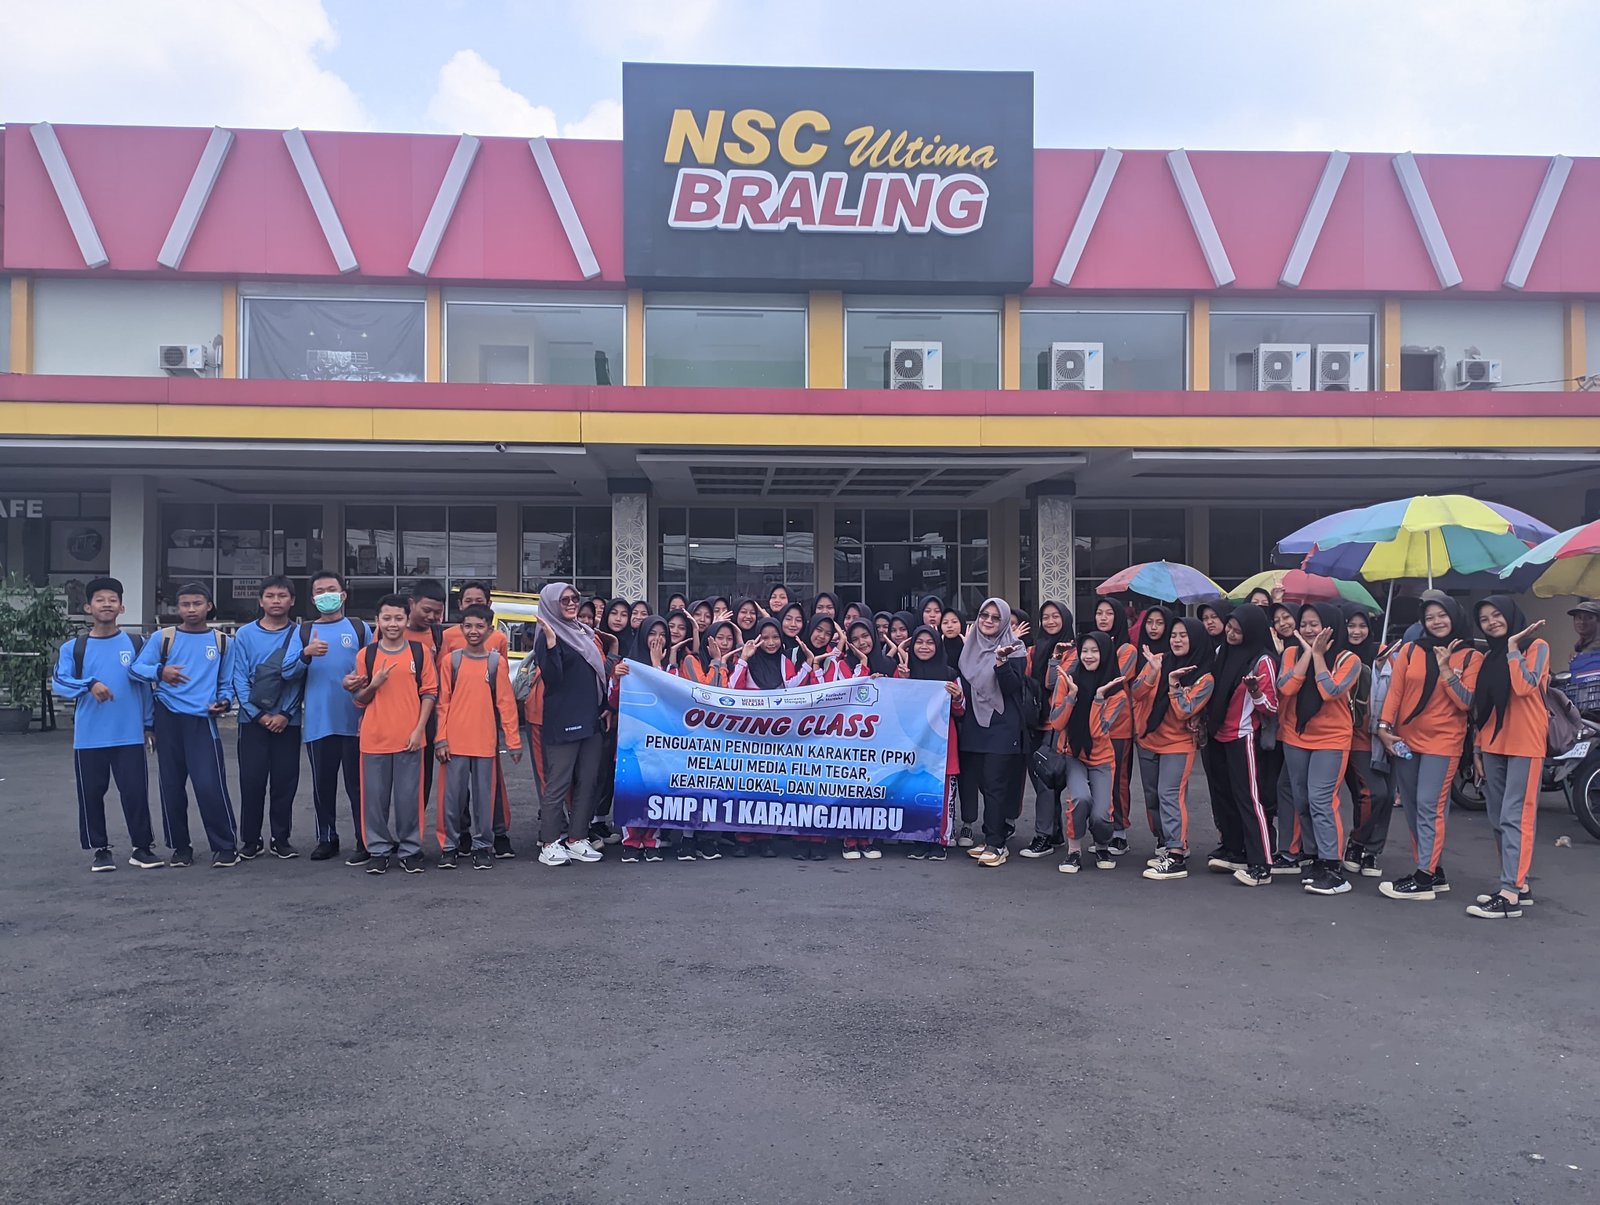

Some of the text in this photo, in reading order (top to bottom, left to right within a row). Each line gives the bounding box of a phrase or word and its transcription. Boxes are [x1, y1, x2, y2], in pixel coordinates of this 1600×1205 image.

[664, 109, 999, 170] NSC Ultima
[668, 167, 989, 236] BRALING
[684, 708, 881, 739] OUTING CLASS
[646, 736, 916, 765] PENGUATAN PENDIDIKAN KARAKTER (PPK)
[687, 757, 872, 782] MELALUI MEDIA FILM TEGAR,
[670, 773, 886, 799] KEARIFAN LOKAL, DAN NUMERASI
[648, 795, 904, 832] SMP N 1 KARANGJAMBU
